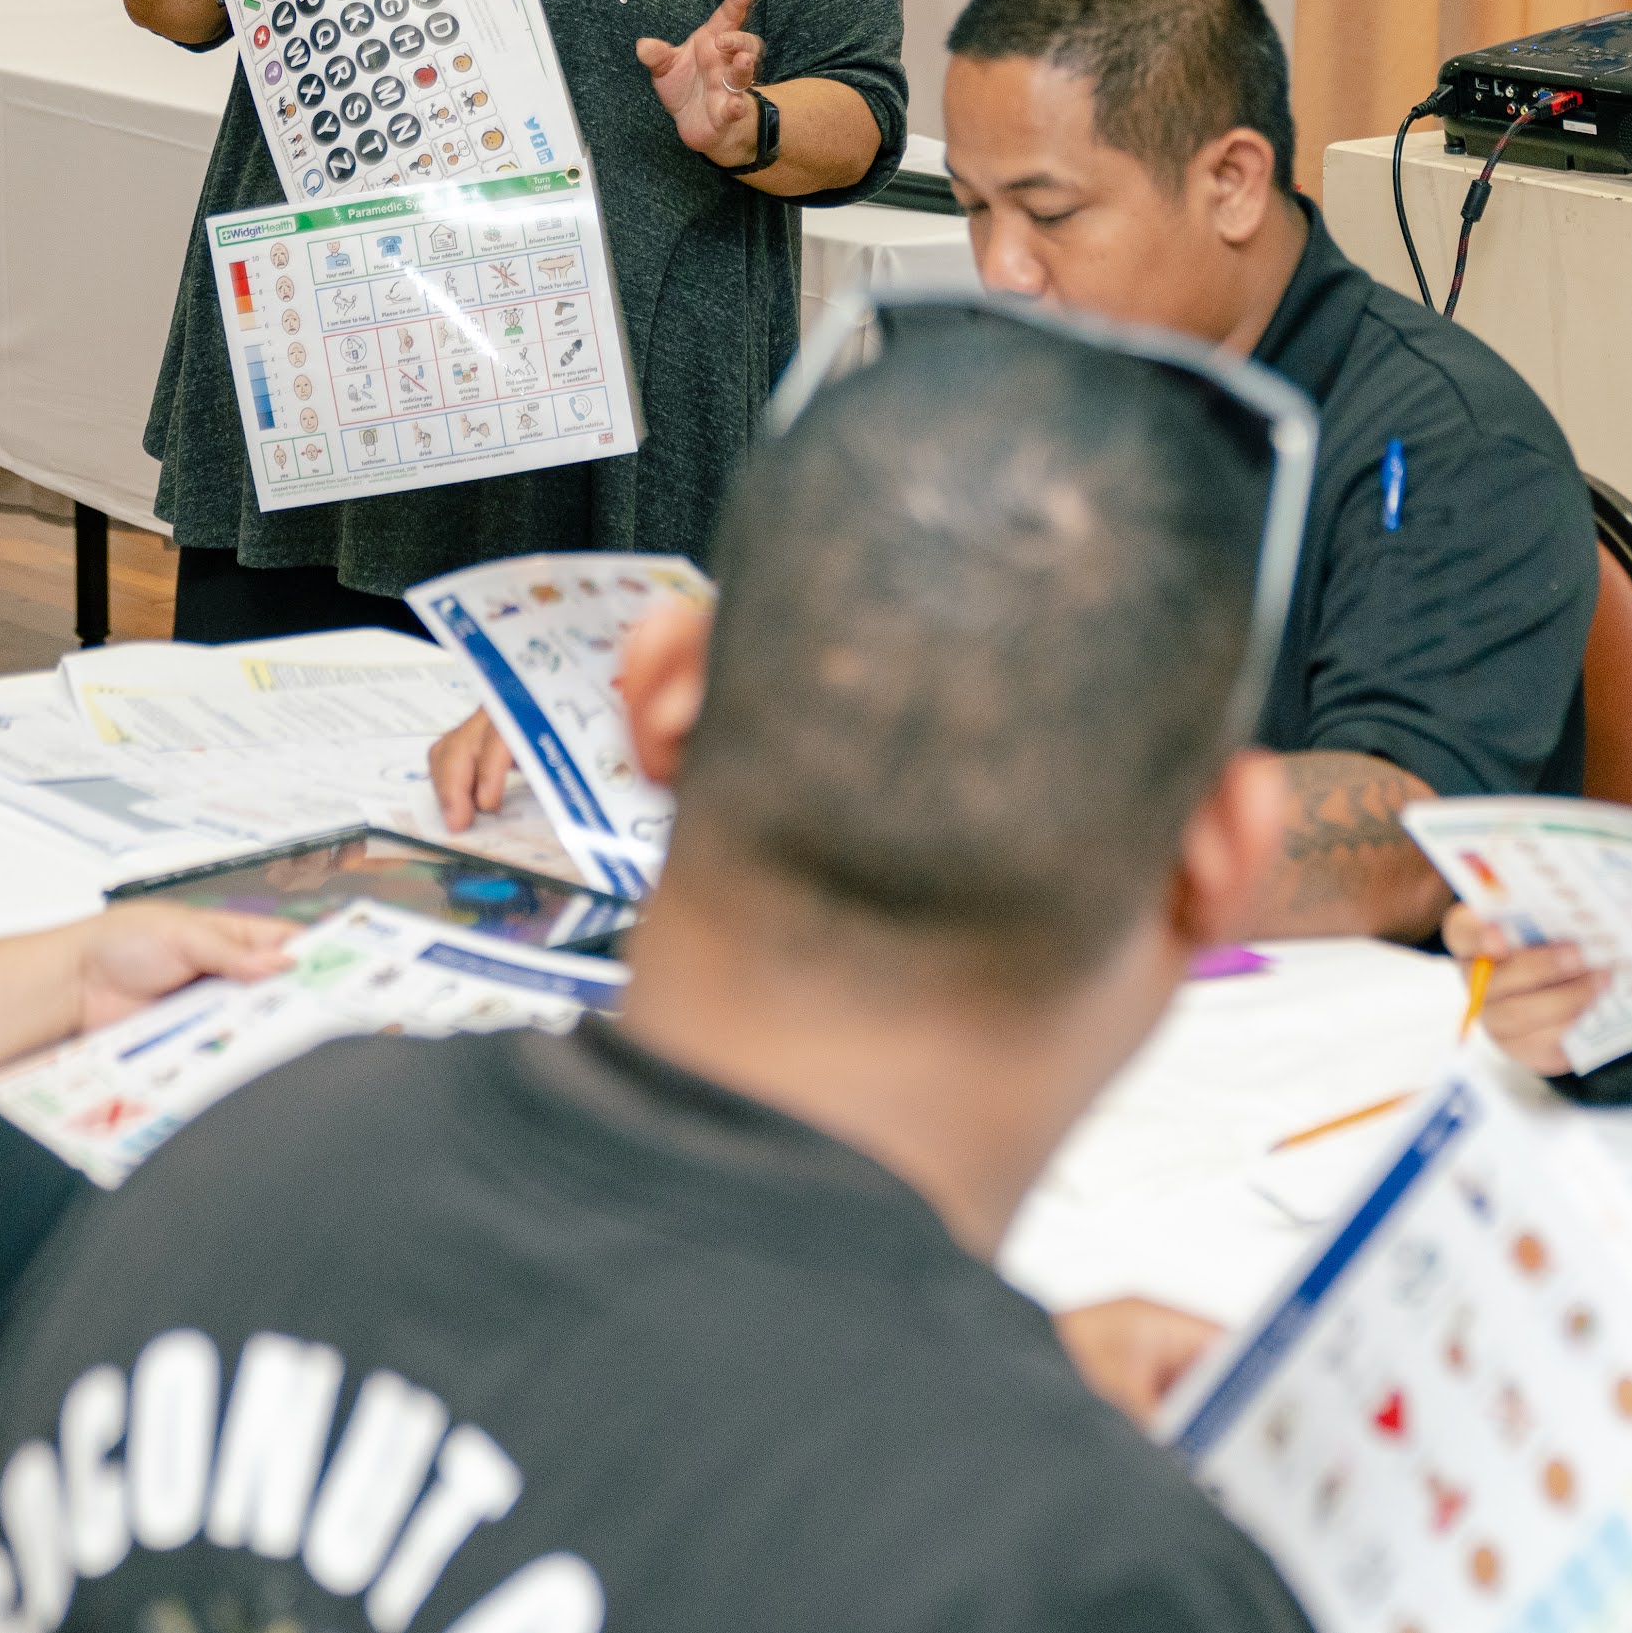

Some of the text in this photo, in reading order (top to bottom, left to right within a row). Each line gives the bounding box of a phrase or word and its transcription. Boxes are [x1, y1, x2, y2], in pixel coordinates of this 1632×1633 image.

[532, 176, 551, 185] Turn
[347, 201, 403, 220] Paramedic
[229, 219, 295, 241] WidgitHealth
